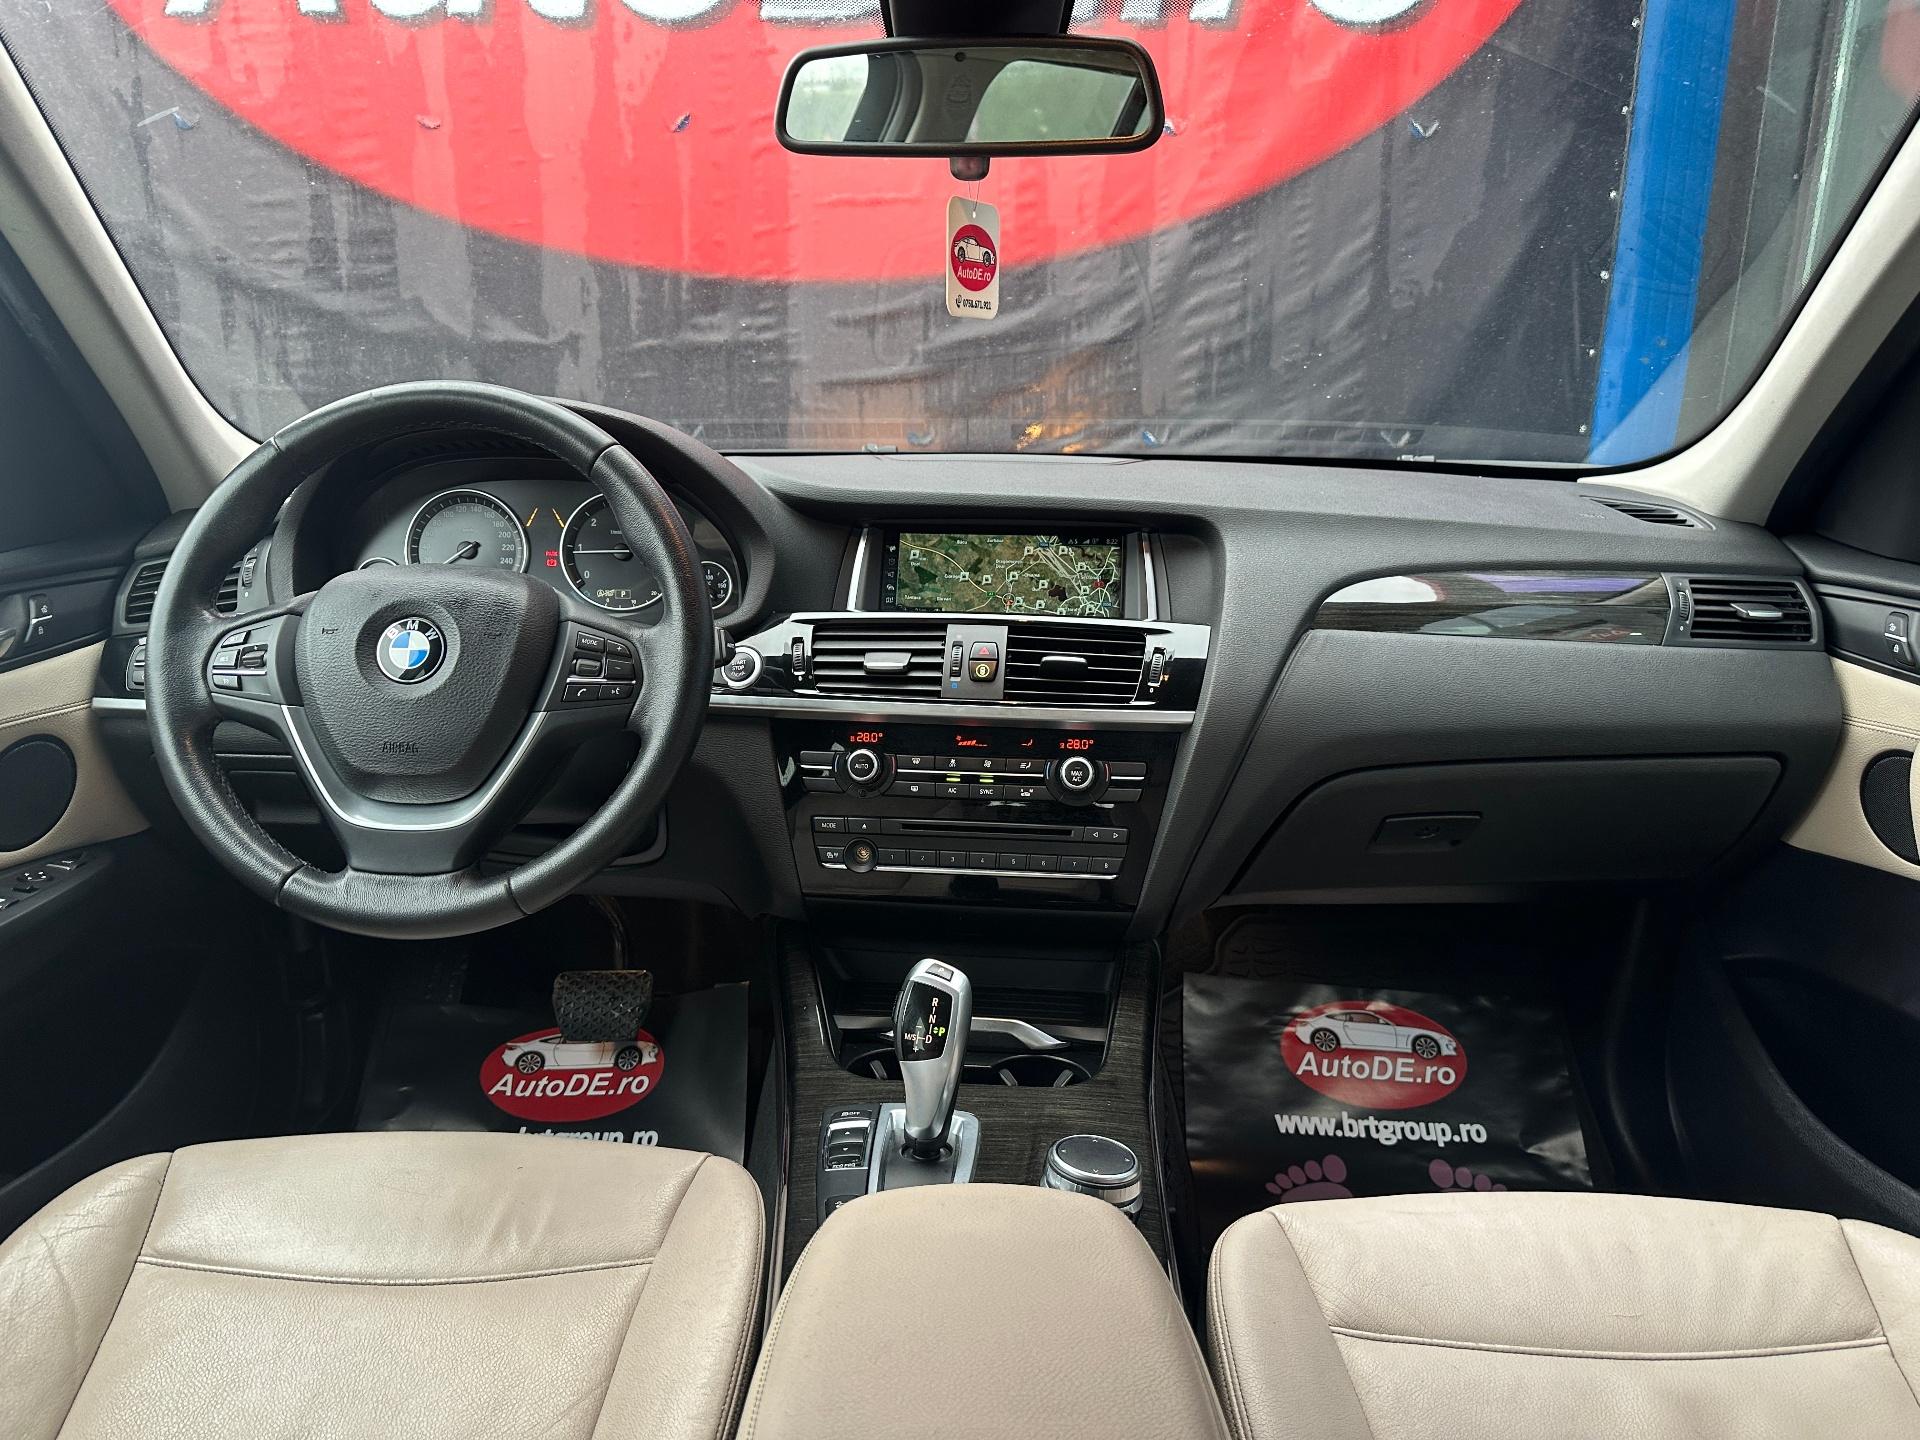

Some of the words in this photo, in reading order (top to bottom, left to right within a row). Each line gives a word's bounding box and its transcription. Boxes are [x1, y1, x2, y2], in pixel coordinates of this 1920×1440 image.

[957, 266, 991, 282] AutoDE.ro
[470, 505, 482, 513] 140
[591, 519, 597, 527] 2
[502, 543, 515, 551] 220
[500, 556, 513, 564] 240
[584, 571, 590, 579] 0
[386, 620, 439, 640] BMW
[581, 638, 598, 646] MODE
[856, 732, 883, 743] 28.0°
[1066, 739, 1094, 750] 28.0°
[932, 998, 939, 1006] R
[928, 1014, 936, 1023] N
[939, 1027, 945, 1036] P
[925, 1035, 932, 1043] D
[1296, 1050, 1457, 1086] AutoDE.ro
[488, 1072, 649, 1098] AutoDE.ro
[1274, 1110, 1487, 1148] www.brtgroup.ro
